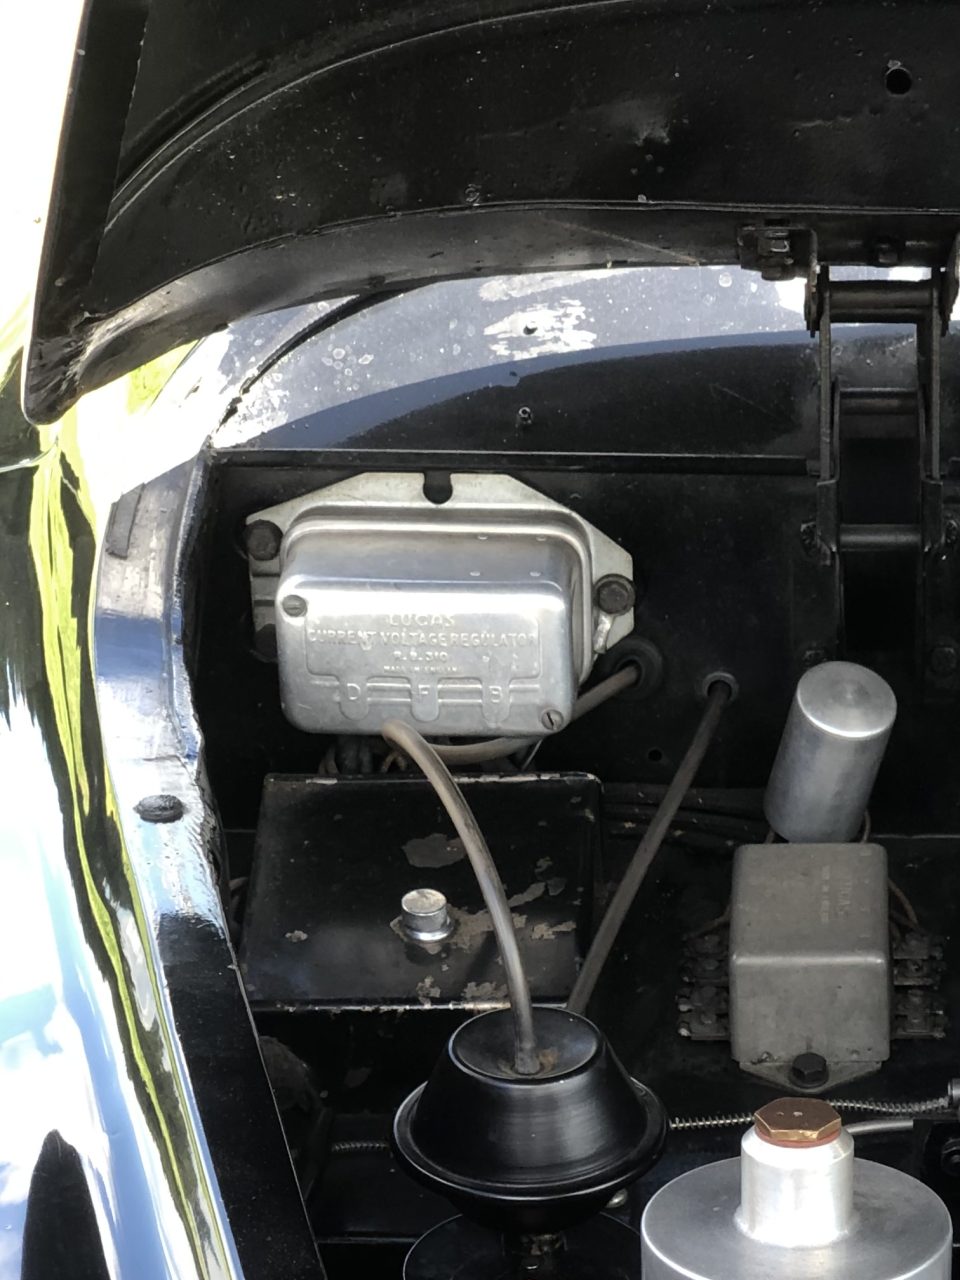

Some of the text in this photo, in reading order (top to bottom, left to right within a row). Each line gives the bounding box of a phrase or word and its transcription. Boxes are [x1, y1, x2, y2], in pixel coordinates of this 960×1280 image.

[390, 614, 455, 626] LUCAS
[307, 630, 537, 647] CURRENT VOLTAGE REGULATOR
[347, 683, 361, 700] D
[418, 684, 430, 699] F
[489, 686, 503, 703] B
